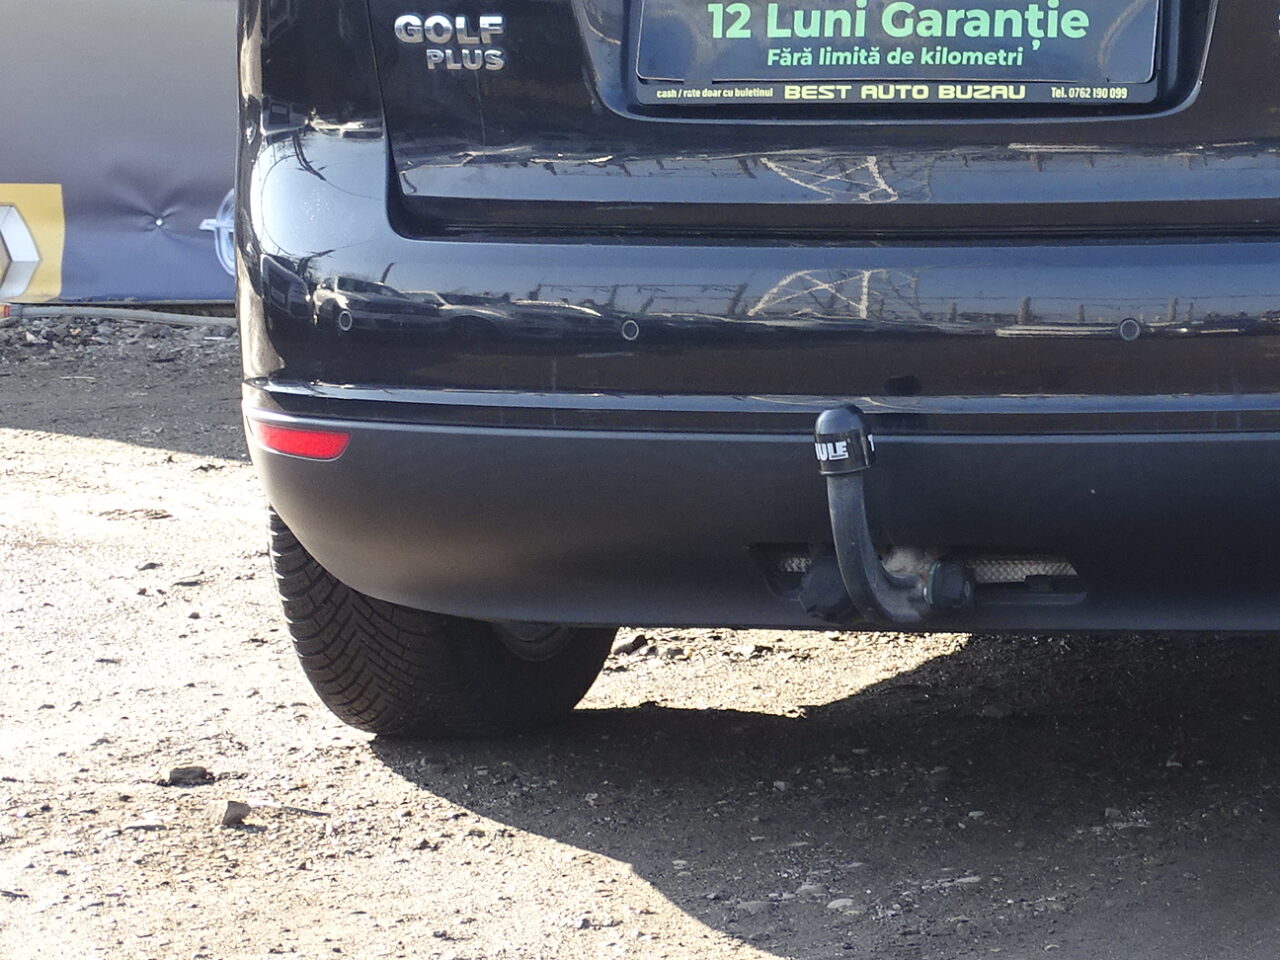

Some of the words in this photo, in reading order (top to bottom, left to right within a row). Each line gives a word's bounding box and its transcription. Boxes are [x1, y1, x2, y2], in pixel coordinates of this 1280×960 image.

[394, 14, 504, 45] GOLF
[707, 2, 752, 38] 12
[426, 48, 505, 71] PLUS
[767, 45, 813, 66] Fără
[819, 45, 880, 66] limită
[886, 45, 914, 65] de
[920, 45, 1024, 66] kilometri
[656, 88, 677, 99] cash
[702, 87, 722, 98] doar
[784, 85, 852, 100] BEST
[861, 85, 930, 100] AUTO
[938, 85, 1026, 100] BUZAU
[1051, 86, 1068, 99] Tel.
[1069, 87, 1091, 99] 0762
[1093, 87, 1108, 99] 190
[1109, 87, 1128, 99] 099
